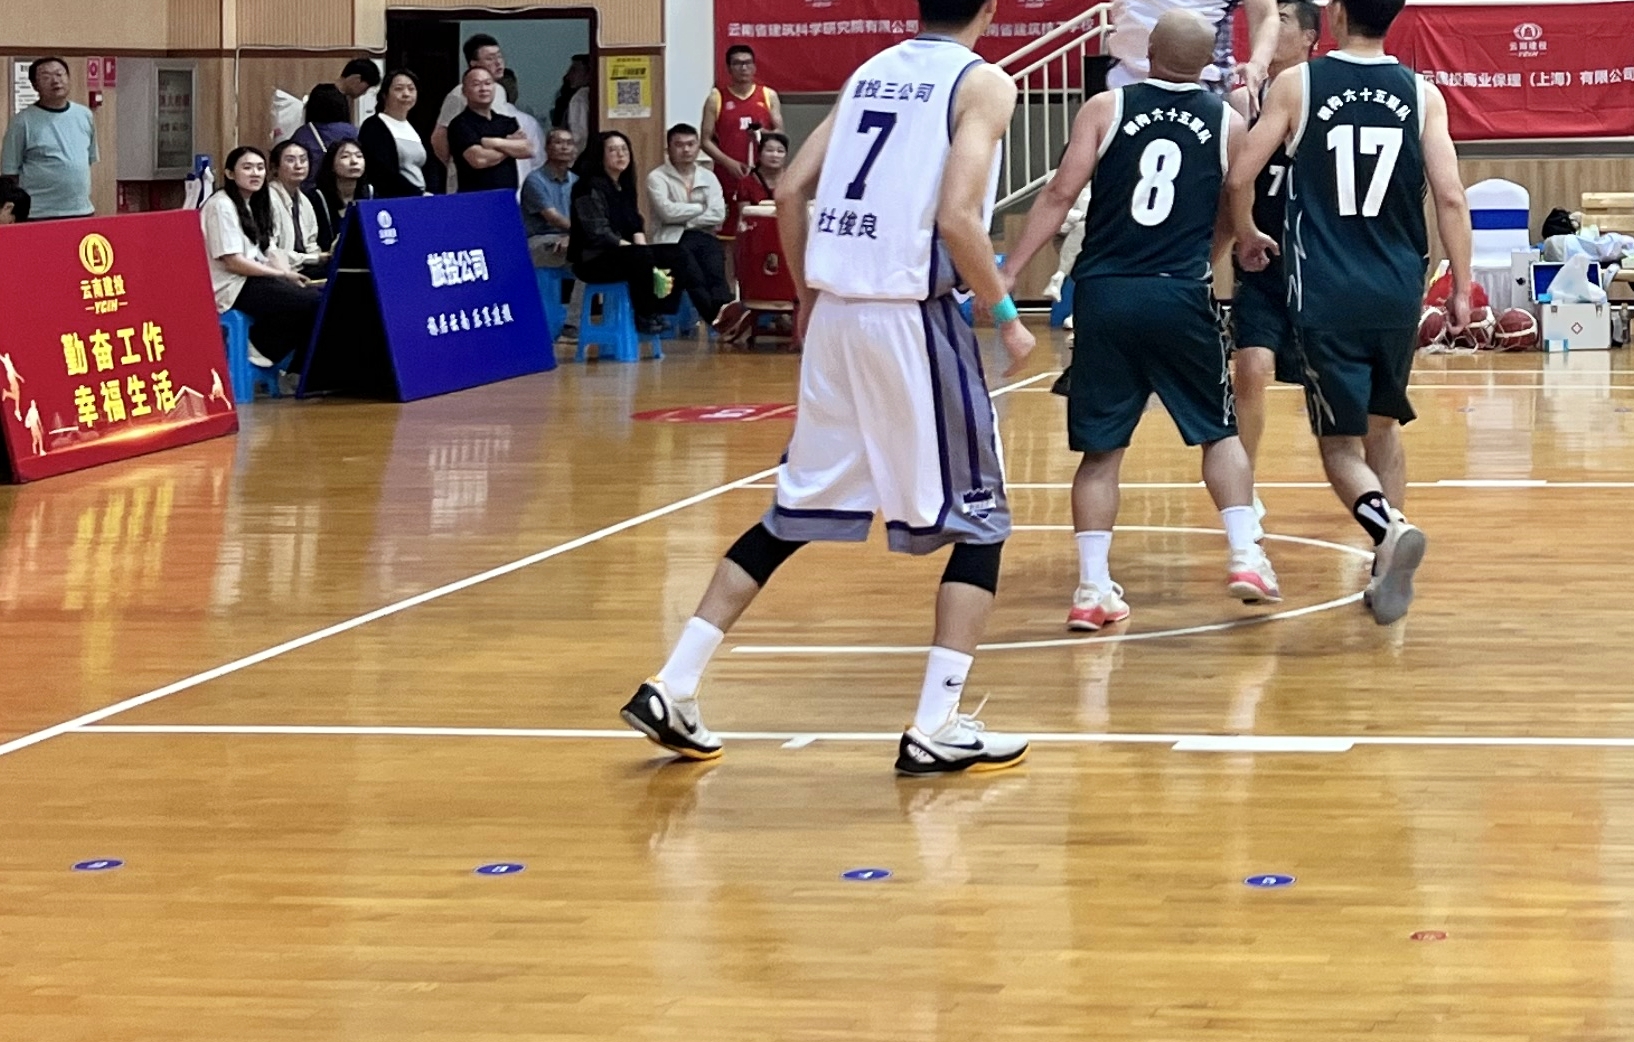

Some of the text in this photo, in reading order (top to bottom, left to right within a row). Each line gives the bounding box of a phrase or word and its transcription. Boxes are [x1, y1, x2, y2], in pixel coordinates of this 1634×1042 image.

[845, 109, 898, 200] 7
[1131, 138, 1183, 227] 8
[1326, 124, 1404, 217] 17
[80, 274, 126, 300] 云南建投
[60, 321, 165, 376] 勤奋工作
[74, 369, 176, 428] 幸福生活
